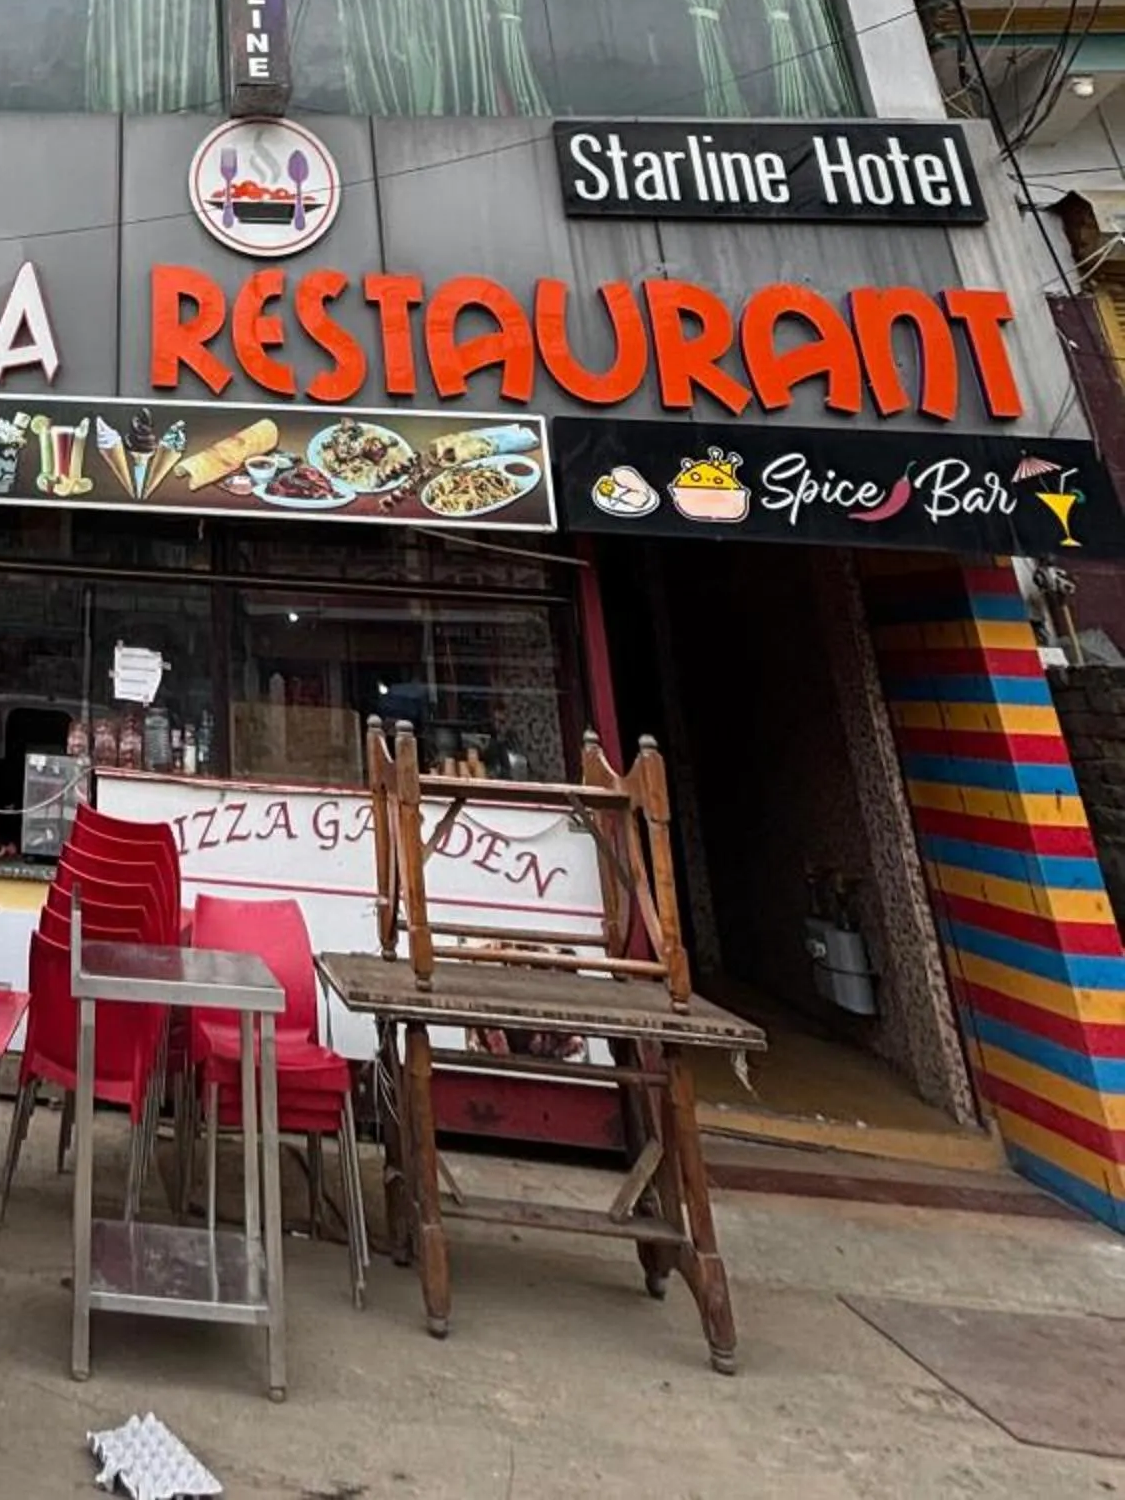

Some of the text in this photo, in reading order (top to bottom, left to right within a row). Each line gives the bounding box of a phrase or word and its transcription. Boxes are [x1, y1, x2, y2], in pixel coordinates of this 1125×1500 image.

[570, 133, 972, 206] Starline Hotel
[150, 263, 1022, 422] RESTAURANT
[761, 453, 1017, 526] Spice Bar
[173, 800, 567, 898] IZZA GADEN
